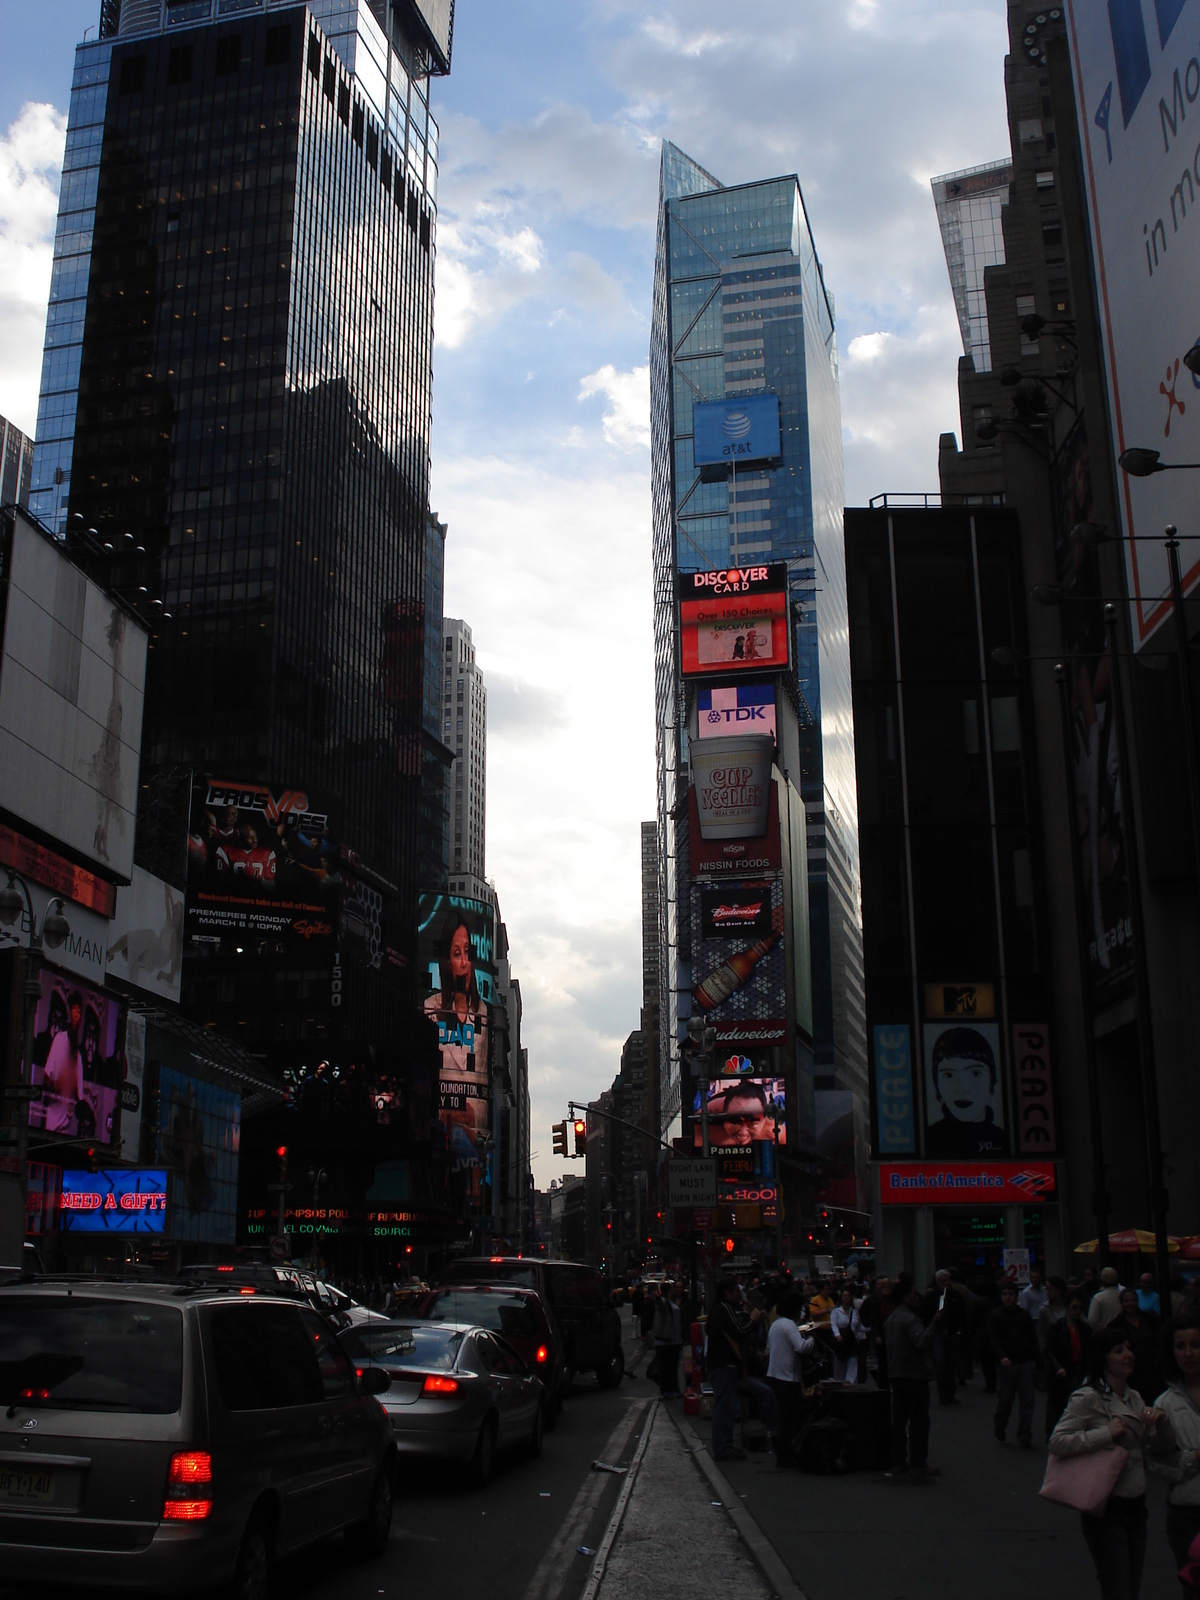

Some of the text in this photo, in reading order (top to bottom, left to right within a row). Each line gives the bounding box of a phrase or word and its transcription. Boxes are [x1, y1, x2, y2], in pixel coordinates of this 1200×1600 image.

[1159, 42, 1200, 153] Mo
[1143, 218, 1166, 277] in
[722, 440, 752, 456] at&t
[694, 567, 769, 587] DISCOVER
[714, 582, 750, 593] CARD
[697, 607, 773, 620] Over 150 Choices
[714, 622, 755, 632] DISCOVER
[721, 706, 766, 722] TDK
[710, 767, 753, 789] CUP
[207, 786, 268, 810] PROS
[701, 785, 763, 810] NOODLES
[269, 811, 327, 834] JOES
[723, 845, 745, 854] NISSIN
[25, 857, 59, 888] SPRING
[700, 858, 770, 871] NISSIN FOODS
[198, 892, 229, 903] Weekend
[256, 898, 271, 907] take
[281, 901, 294, 909] Hall
[294, 902, 302, 910] of
[302, 903, 326, 913] Famers
[189, 908, 292, 925] PREMIERES MONDAY
[711, 907, 762, 918] Budweiser
[199, 917, 236, 927] MARCH
[256, 922, 282, 931] 10PM
[293, 919, 332, 939] Spike
[943, 986, 979, 1012] MTV
[439, 1081, 479, 1098] OUNDATION,
[879, 1031, 911, 1146] PEACE
[1018, 1031, 1051, 1143] PEACE
[450, 1096, 459, 1108] TO
[711, 1146, 752, 1155] Panaso
[978, 1141, 1002, 1152] yo...
[451, 1157, 479, 1172] JVC
[670, 1164, 715, 1173] RIGHT LANE
[724, 1160, 753, 1173] FEBRU
[680, 1178, 704, 1188] MUST
[890, 1171, 1005, 1188] Bank of America
[60, 1192, 101, 1209] NEED
[104, 1192, 117, 1209] A
[120, 1193, 167, 1210] GIFT?
[670, 1193, 715, 1202] TURN RIGHT
[718, 1187, 777, 1201] AHOO!
[253, 1210, 266, 1219] UP
[328, 1210, 350, 1219] POLL
[1008, 1264, 1018, 1282] 2
